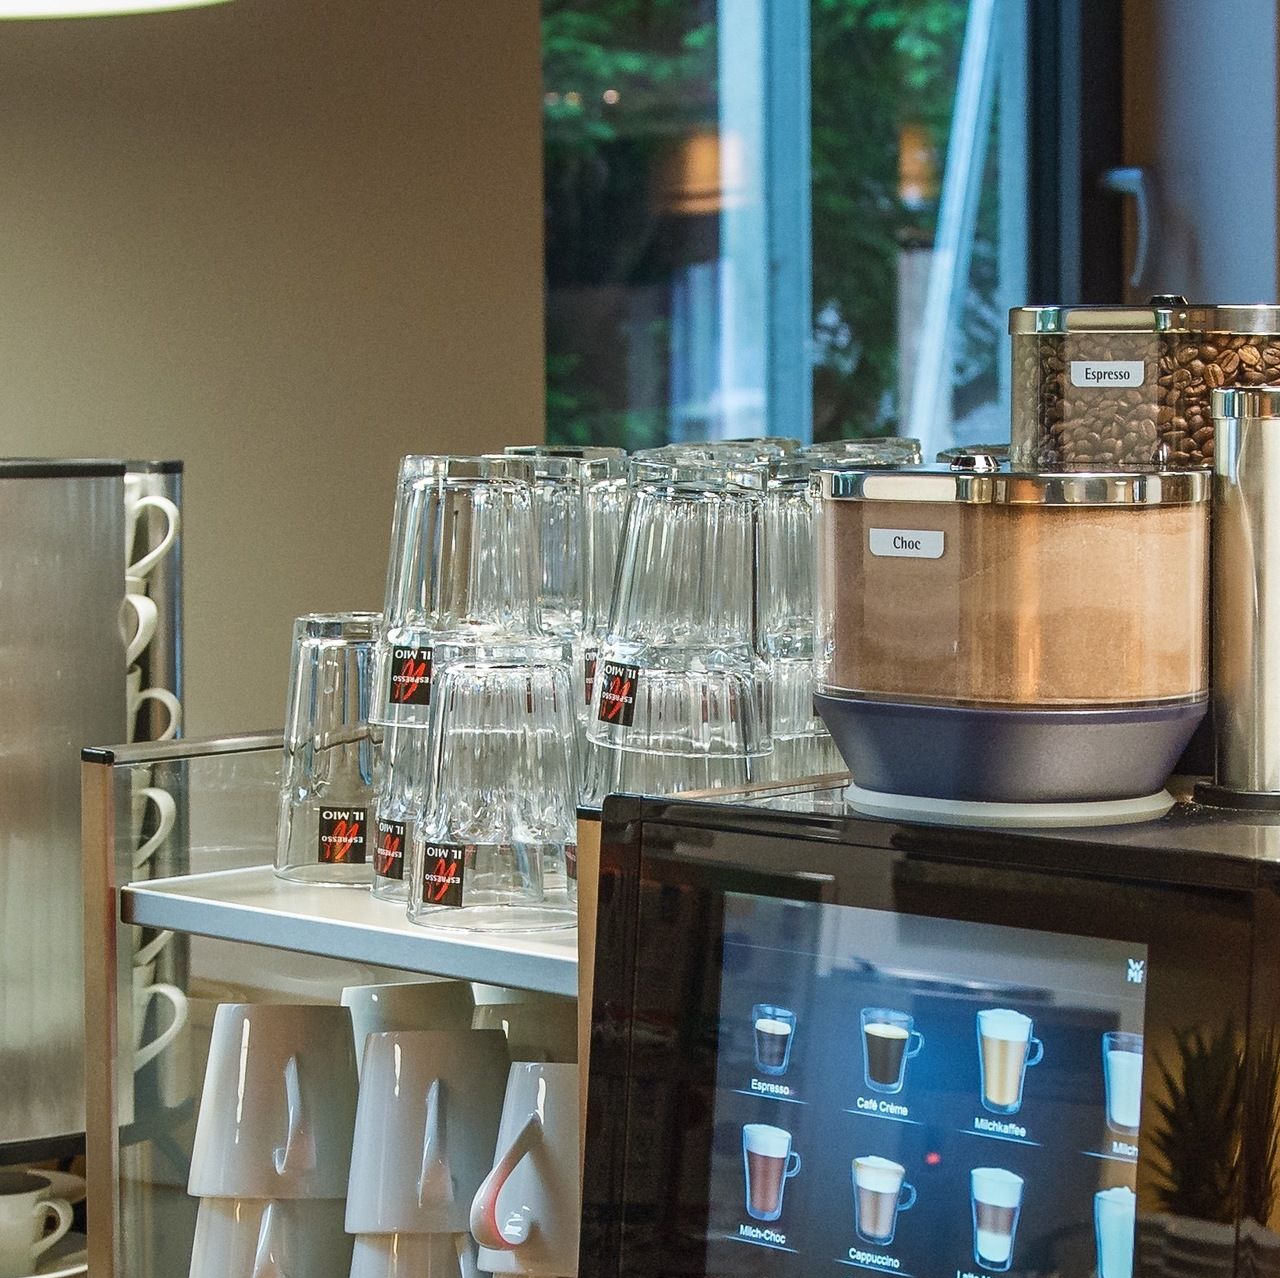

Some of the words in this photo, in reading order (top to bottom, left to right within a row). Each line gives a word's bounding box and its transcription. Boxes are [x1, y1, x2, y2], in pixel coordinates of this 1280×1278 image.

[1085, 367, 1130, 383] Espresso
[893, 535, 921, 550] Choc
[395, 649, 418, 660] MIO
[421, 650, 432, 660] IL
[605, 664, 625, 677] MIO
[626, 668, 637, 680] IL
[392, 675, 430, 684] ESPRESSO
[322, 810, 350, 821] MIO
[353, 811, 364, 821] IL
[395, 825, 404, 836] IL
[321, 835, 363, 844] ESPRESSO
[426, 846, 449, 858] MIO
[451, 849, 462, 860] IL
[425, 873, 461, 884] ESPRESSO
[751, 1078, 790, 1096] Espresso
[856, 1096, 878, 1111] Café
[974, 1117, 1027, 1138] Milchkaffee
[739, 1224, 786, 1245] Milch-Choc
[848, 1247, 900, 1269] Cappuccino
